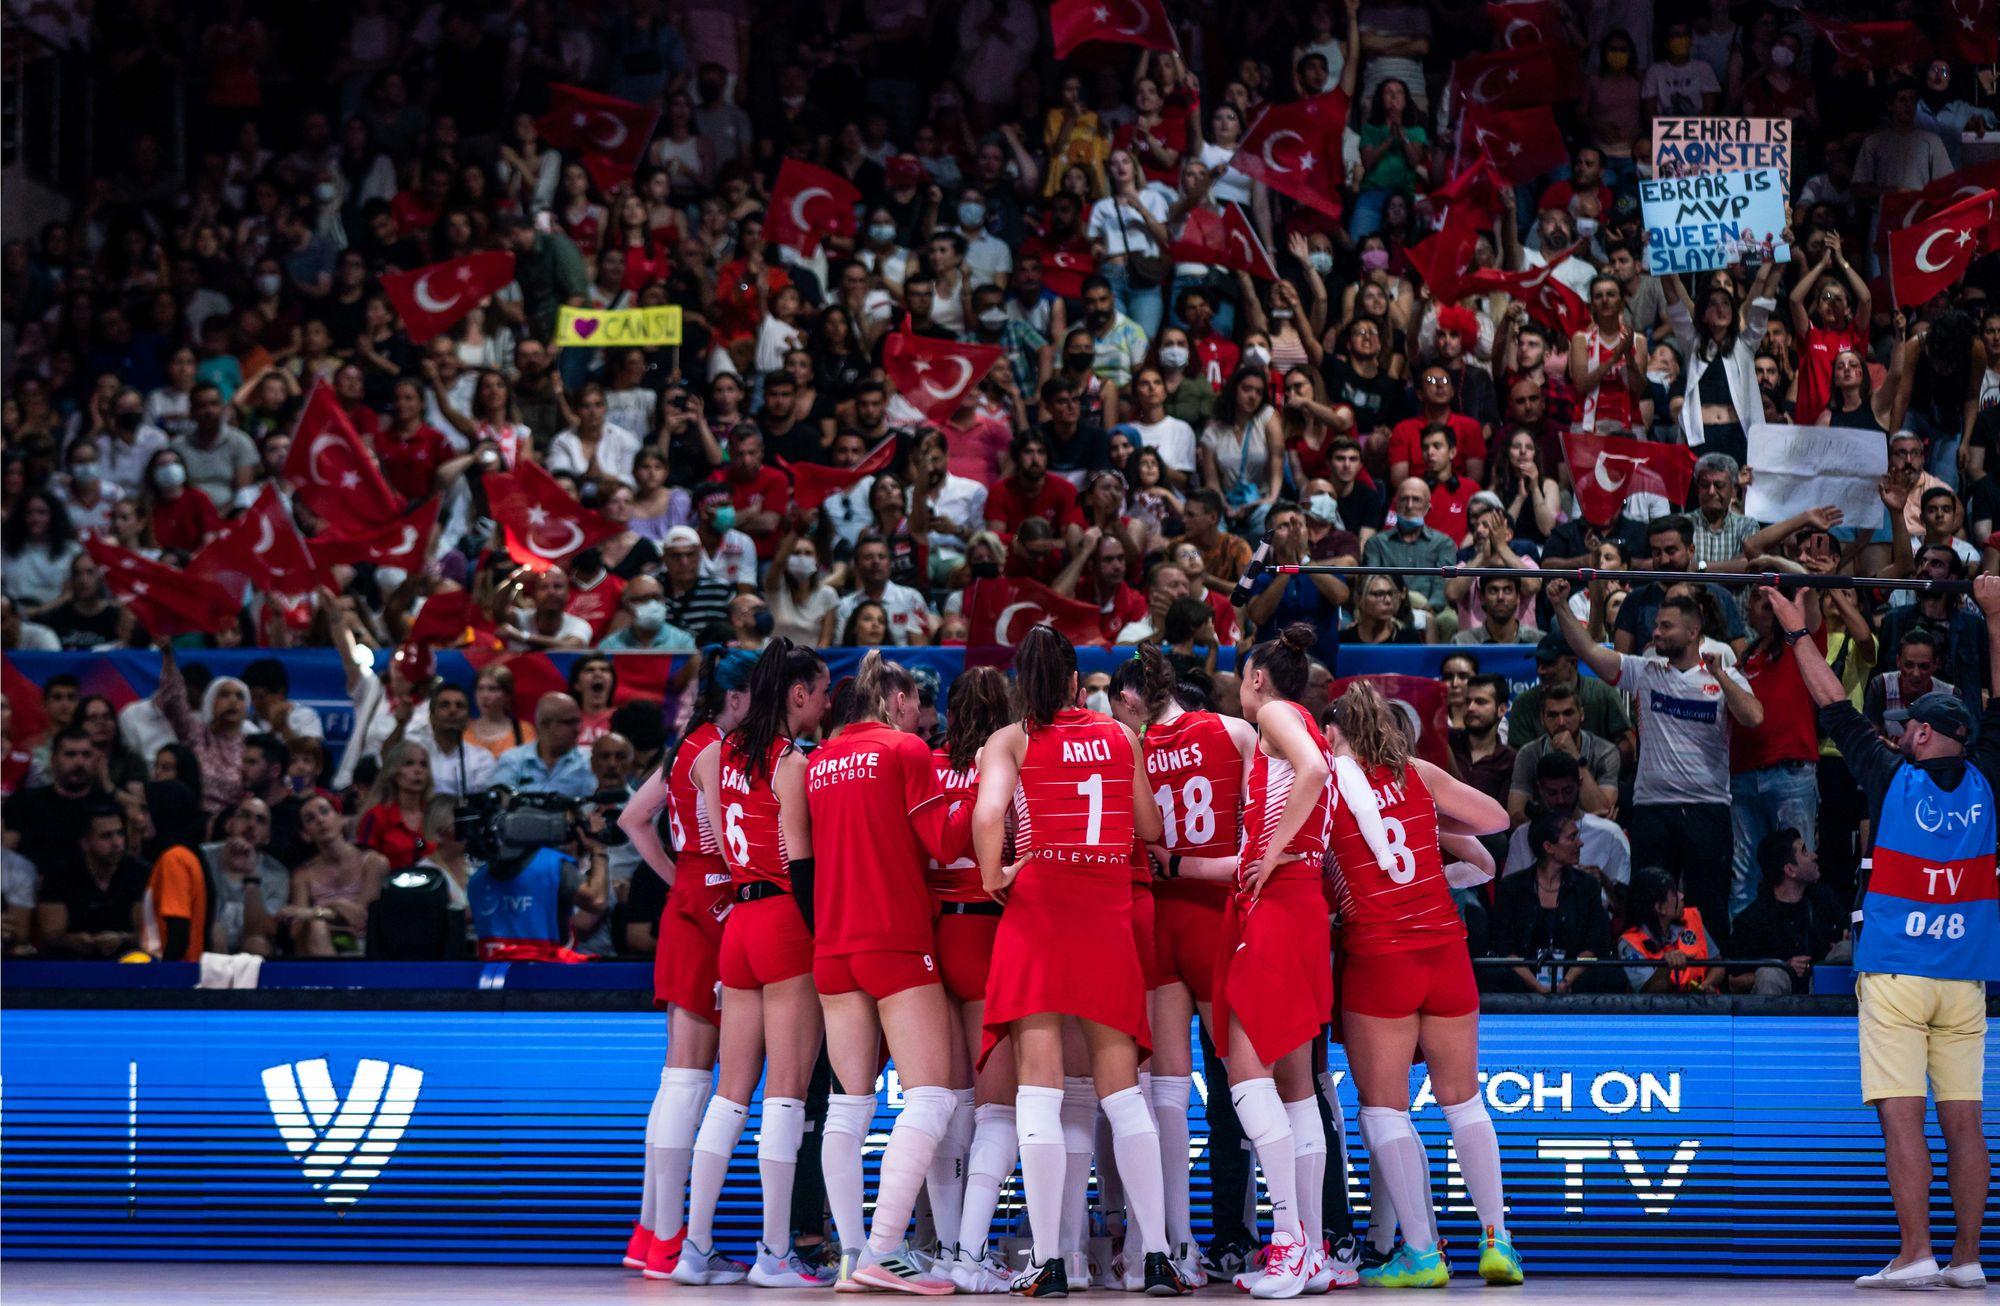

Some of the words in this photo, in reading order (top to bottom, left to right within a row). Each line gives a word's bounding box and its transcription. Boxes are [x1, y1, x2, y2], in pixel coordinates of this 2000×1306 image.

[1658, 118, 1751, 141] ZEHRA
[1765, 120, 1788, 143] IS
[1656, 142, 1789, 168] MONSTER
[1641, 174, 1731, 203] EBRAR
[1743, 171, 1771, 192] IS
[1675, 196, 1750, 225] MVP
[1649, 221, 1740, 248] QUEEN
[1062, 739, 1112, 762] ARICI
[1147, 743, 1203, 774] GÜNEŞ
[809, 766, 877, 792] VOLEYBOL
[810, 752, 879, 780] TÜRKİYE
[1077, 773, 1103, 846] 1
[1372, 781, 1406, 810] BAY
[1154, 776, 1215, 848] 18
[1947, 803, 1982, 831] TVF
[726, 803, 750, 867] 6
[1922, 867, 1964, 896] TV
[1905, 911, 1966, 940] 048
[923, 954, 934, 971] 9
[1590, 1070, 1681, 1113] ON
[1537, 1138, 1702, 1214] TV
